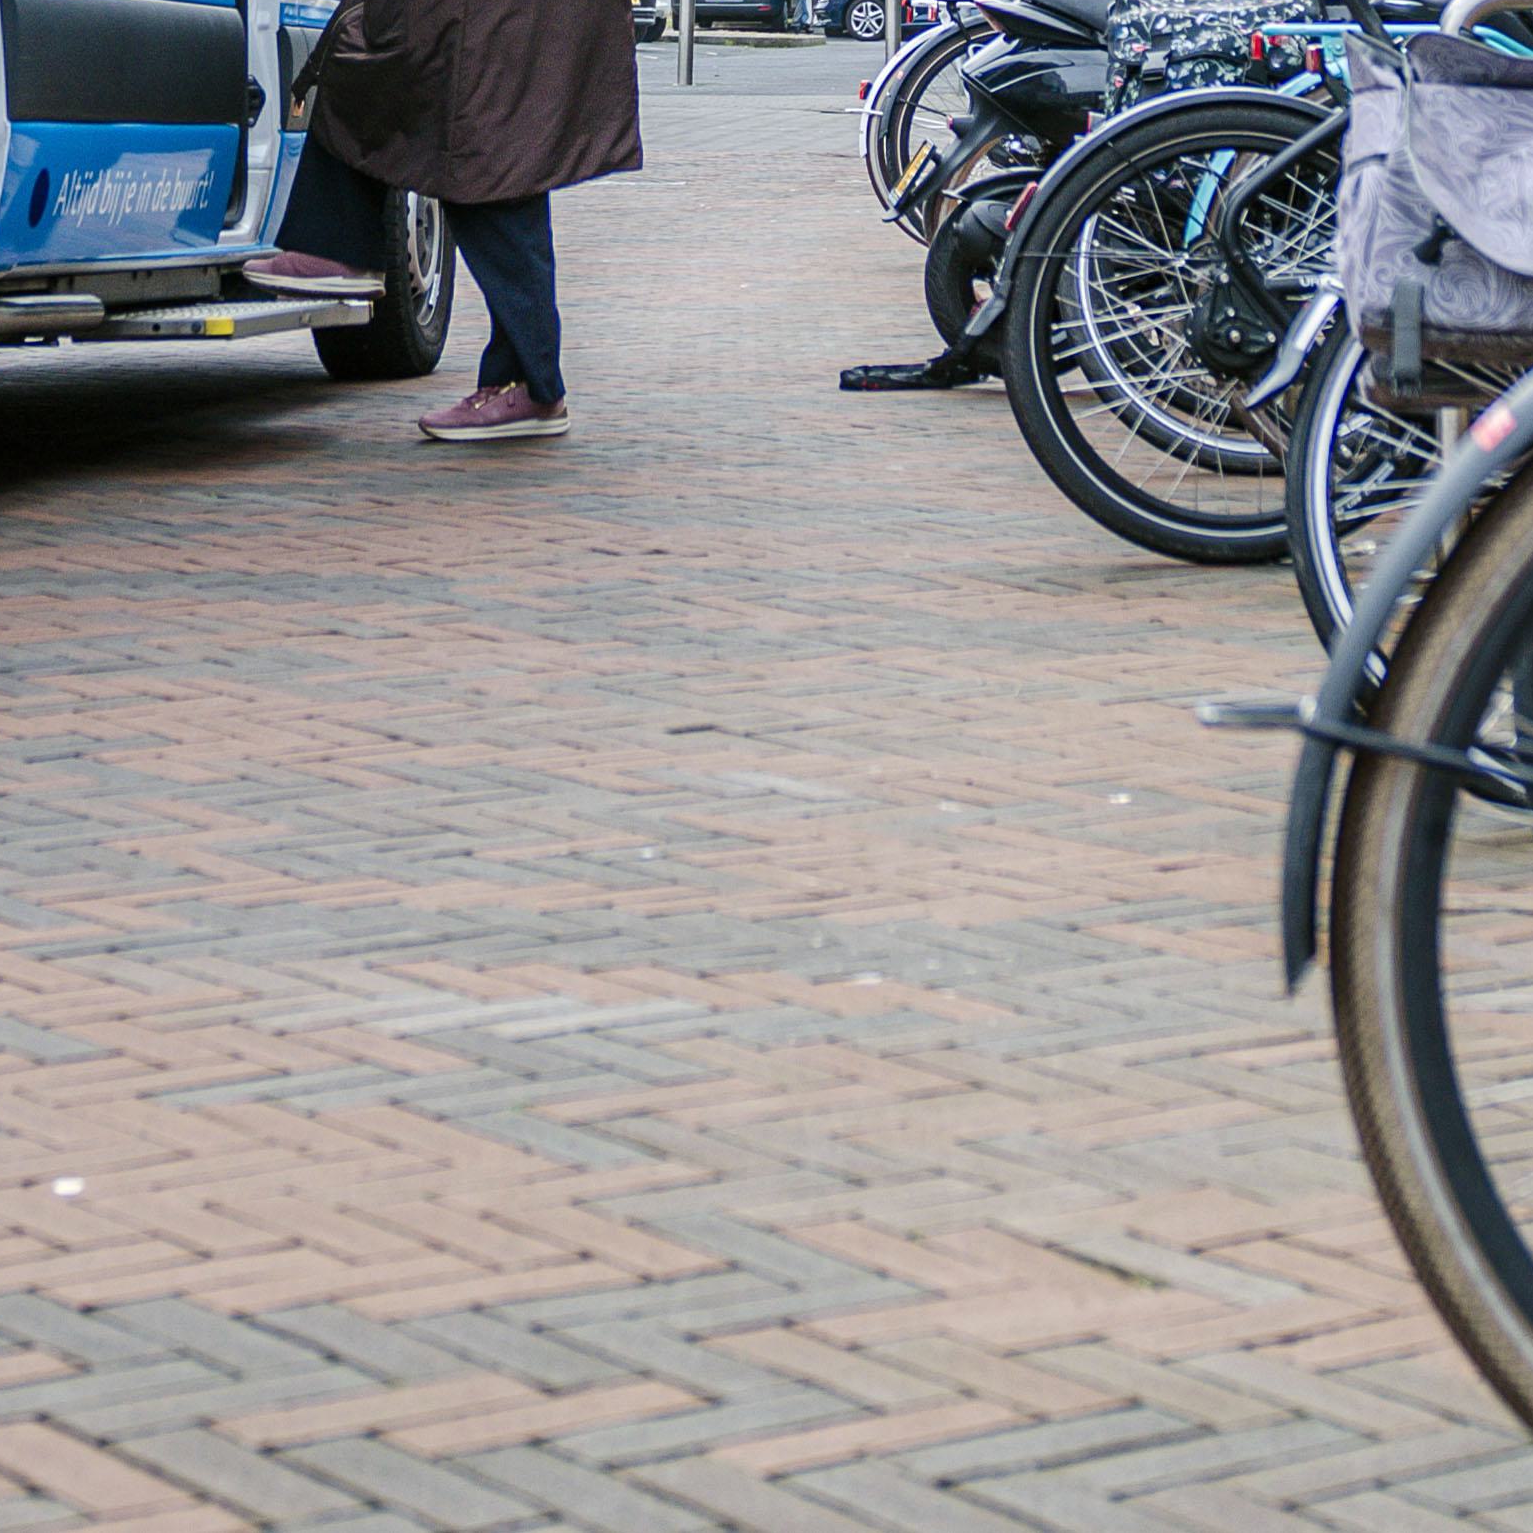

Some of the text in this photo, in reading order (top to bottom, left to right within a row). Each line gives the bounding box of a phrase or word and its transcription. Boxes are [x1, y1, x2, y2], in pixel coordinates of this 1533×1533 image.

[52, 168, 215, 227] Altijd bij je in de buurt!
